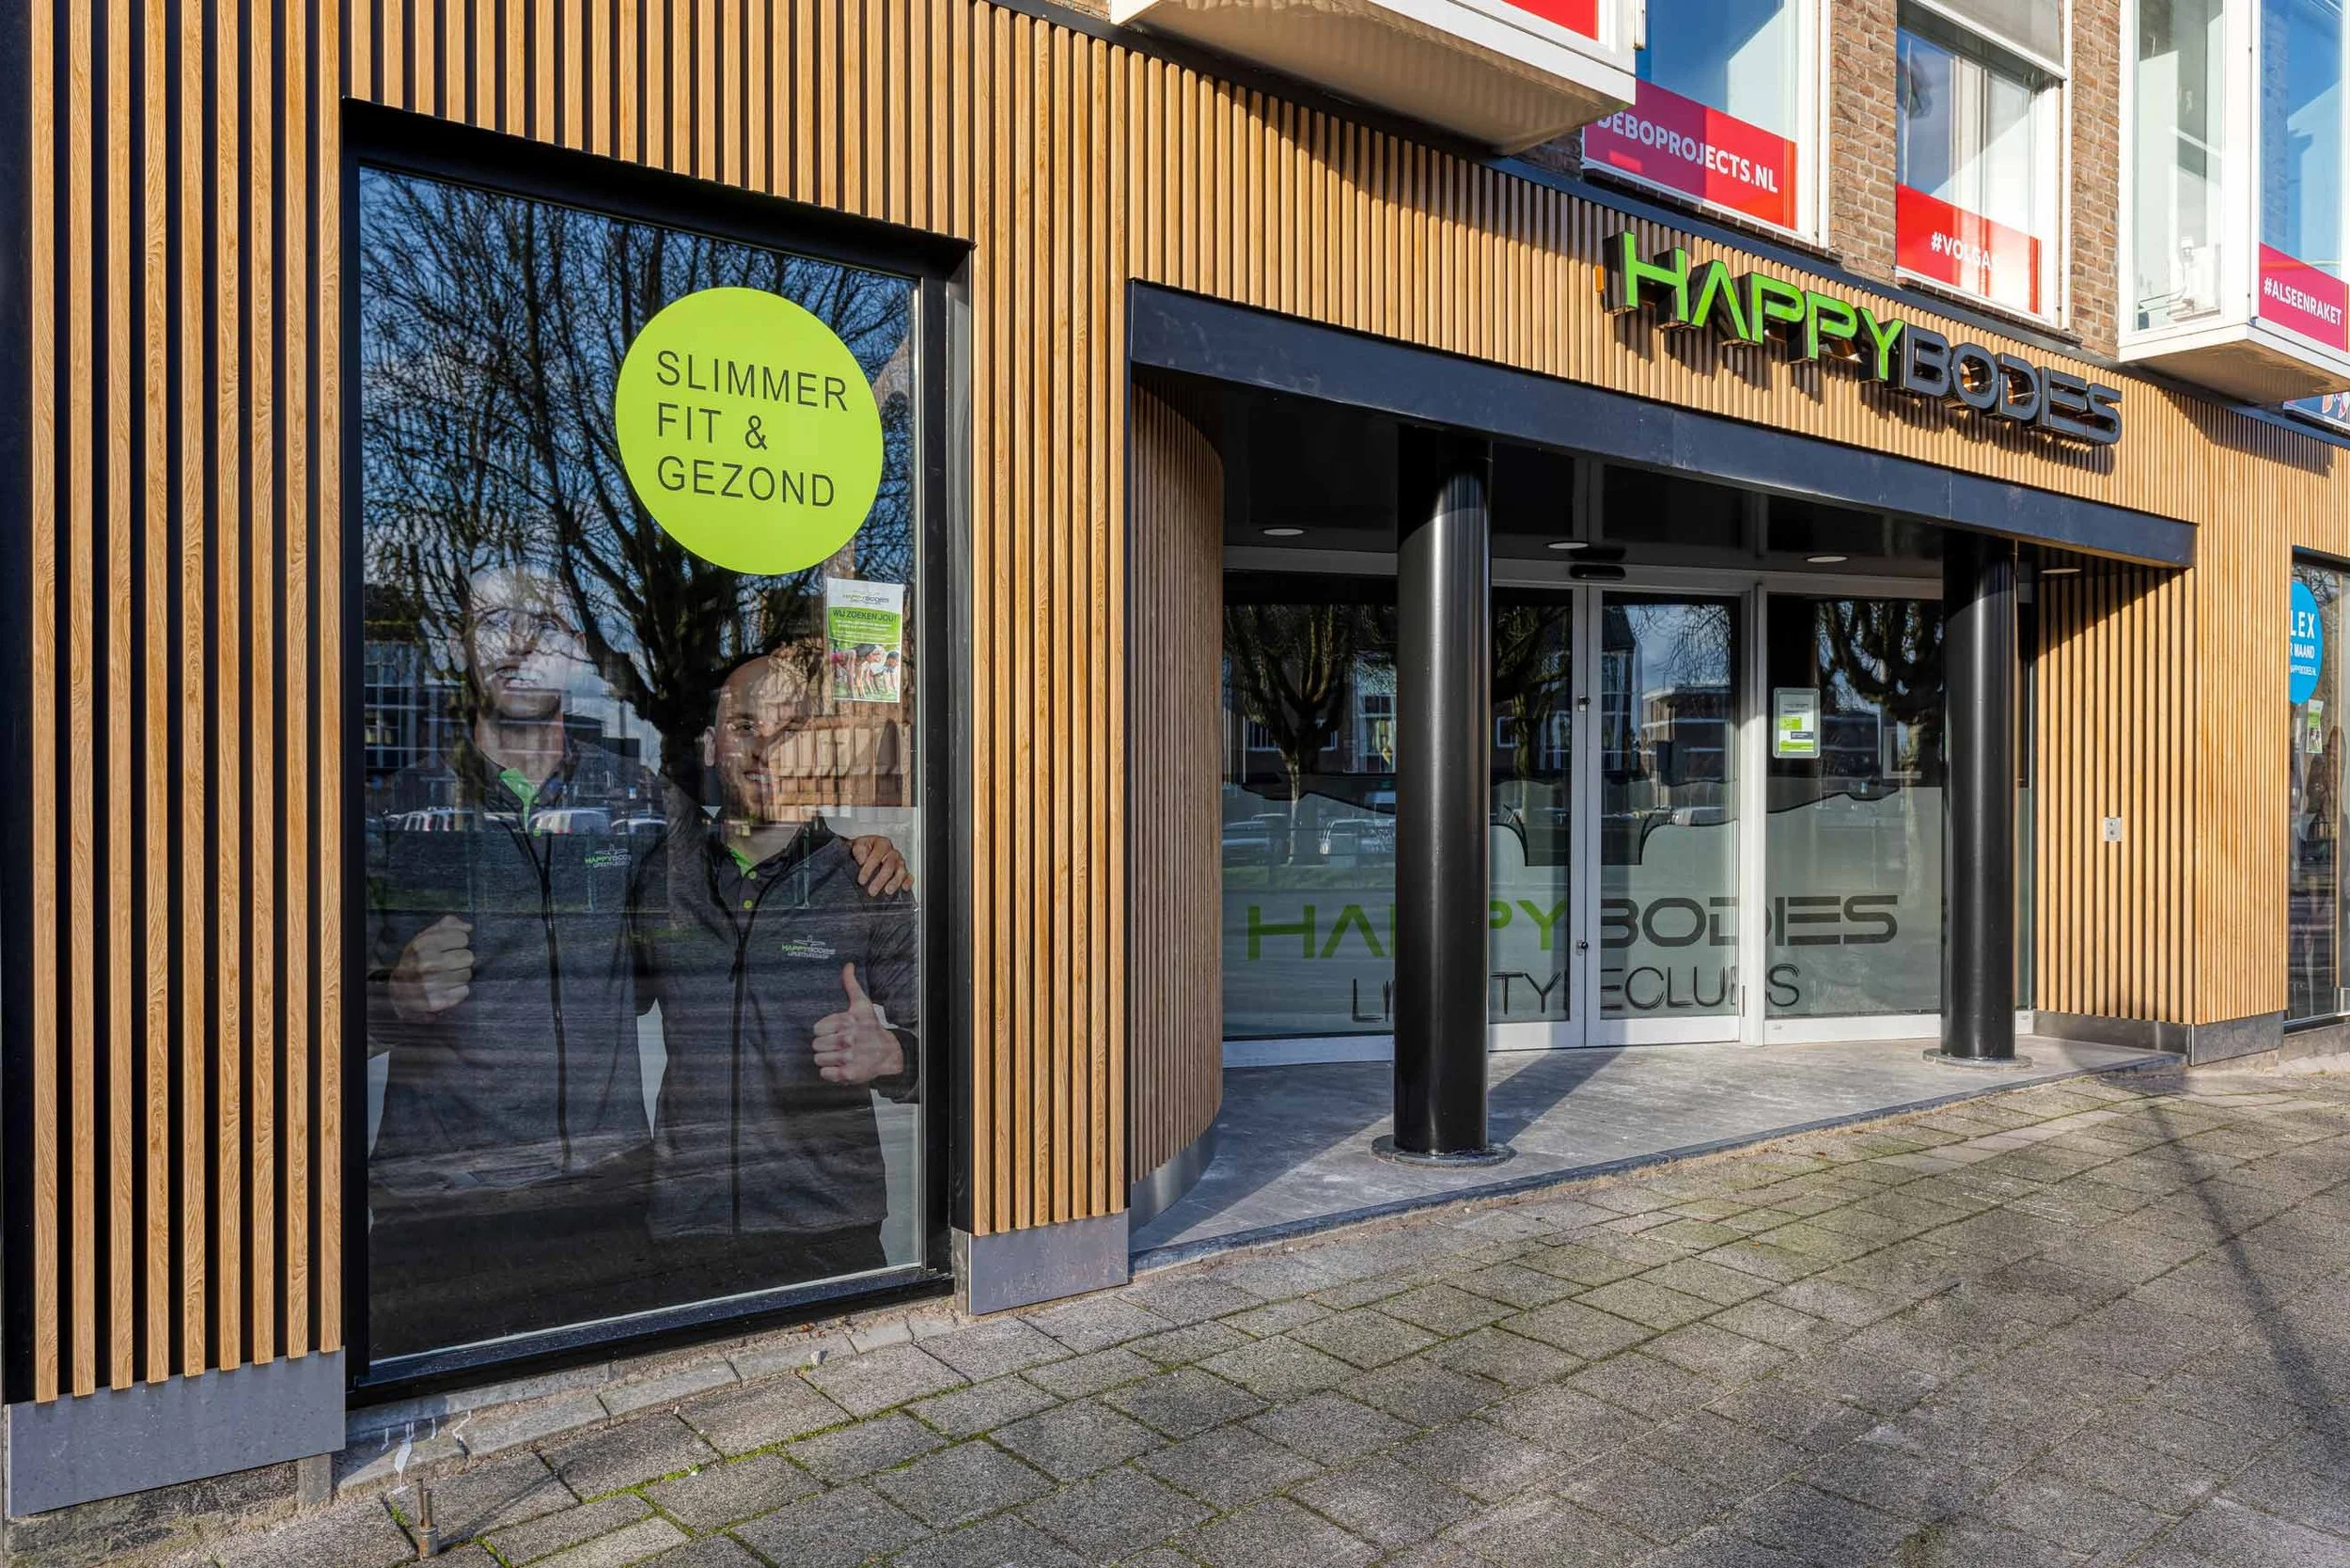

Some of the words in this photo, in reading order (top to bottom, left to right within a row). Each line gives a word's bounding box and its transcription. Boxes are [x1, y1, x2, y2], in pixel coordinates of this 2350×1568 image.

[1931, 231, 2000, 274] #VOLGA
[2264, 276, 2342, 326] #ALSEENRAKET
[656, 350, 848, 412] SLIMMER
[658, 401, 722, 444] FIT
[744, 415, 768, 450] &
[657, 455, 835, 508] GEZOND
[2290, 610, 2315, 639] LEX
